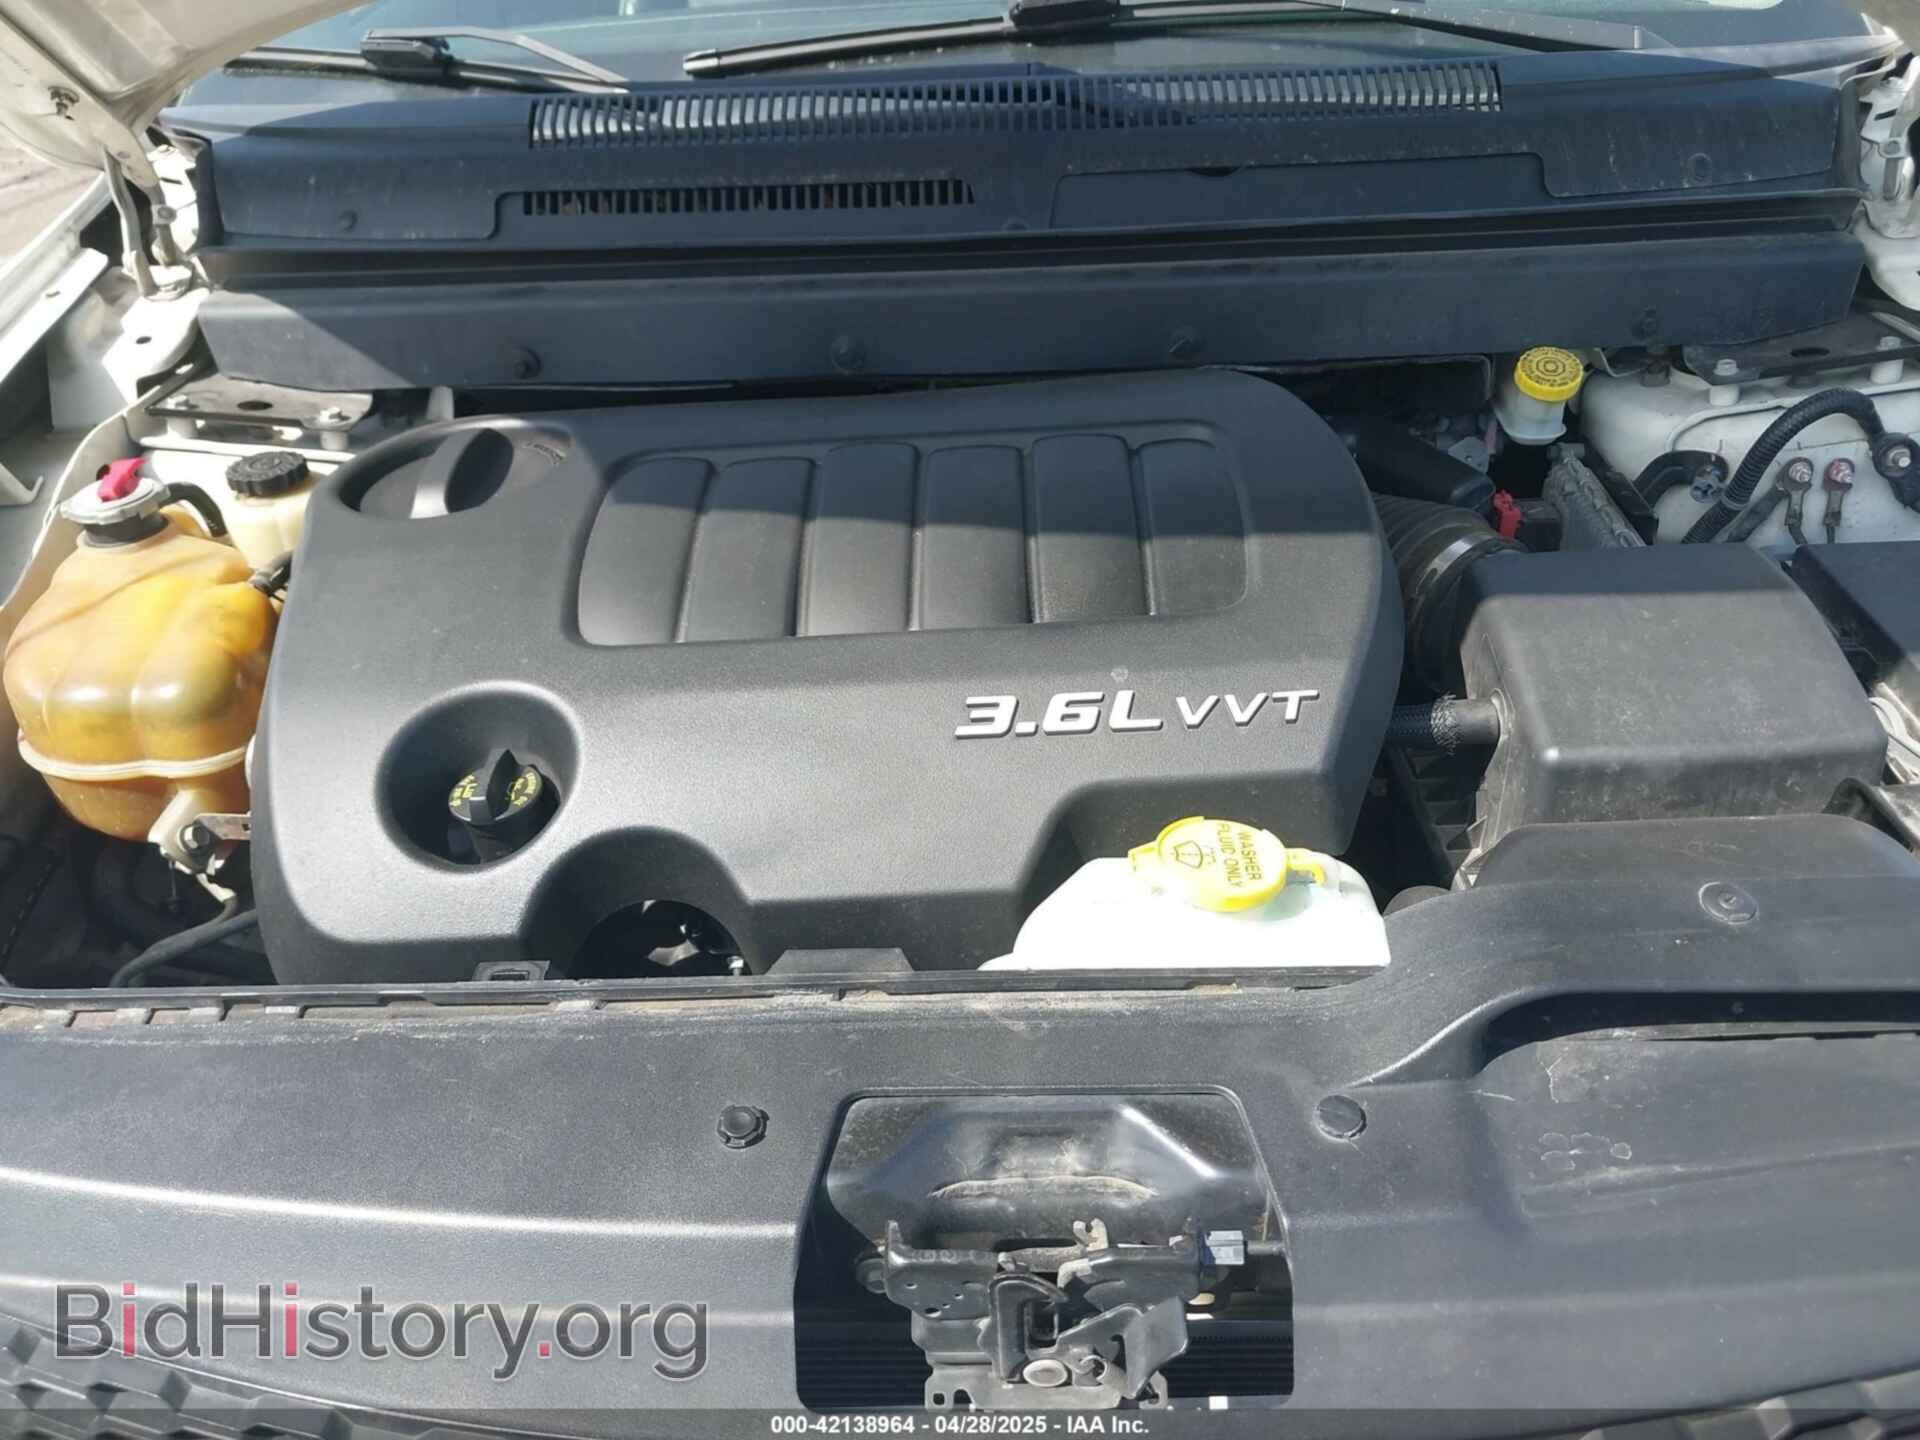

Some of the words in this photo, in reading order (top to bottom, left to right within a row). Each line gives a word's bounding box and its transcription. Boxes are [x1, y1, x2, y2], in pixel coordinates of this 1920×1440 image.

[955, 690, 1163, 739] 3.6L
[1176, 689, 1320, 730] VVT
[1218, 824, 1236, 855] FLUID
[1238, 832, 1262, 880] WASHER
[1224, 858, 1242, 887] ONLY
